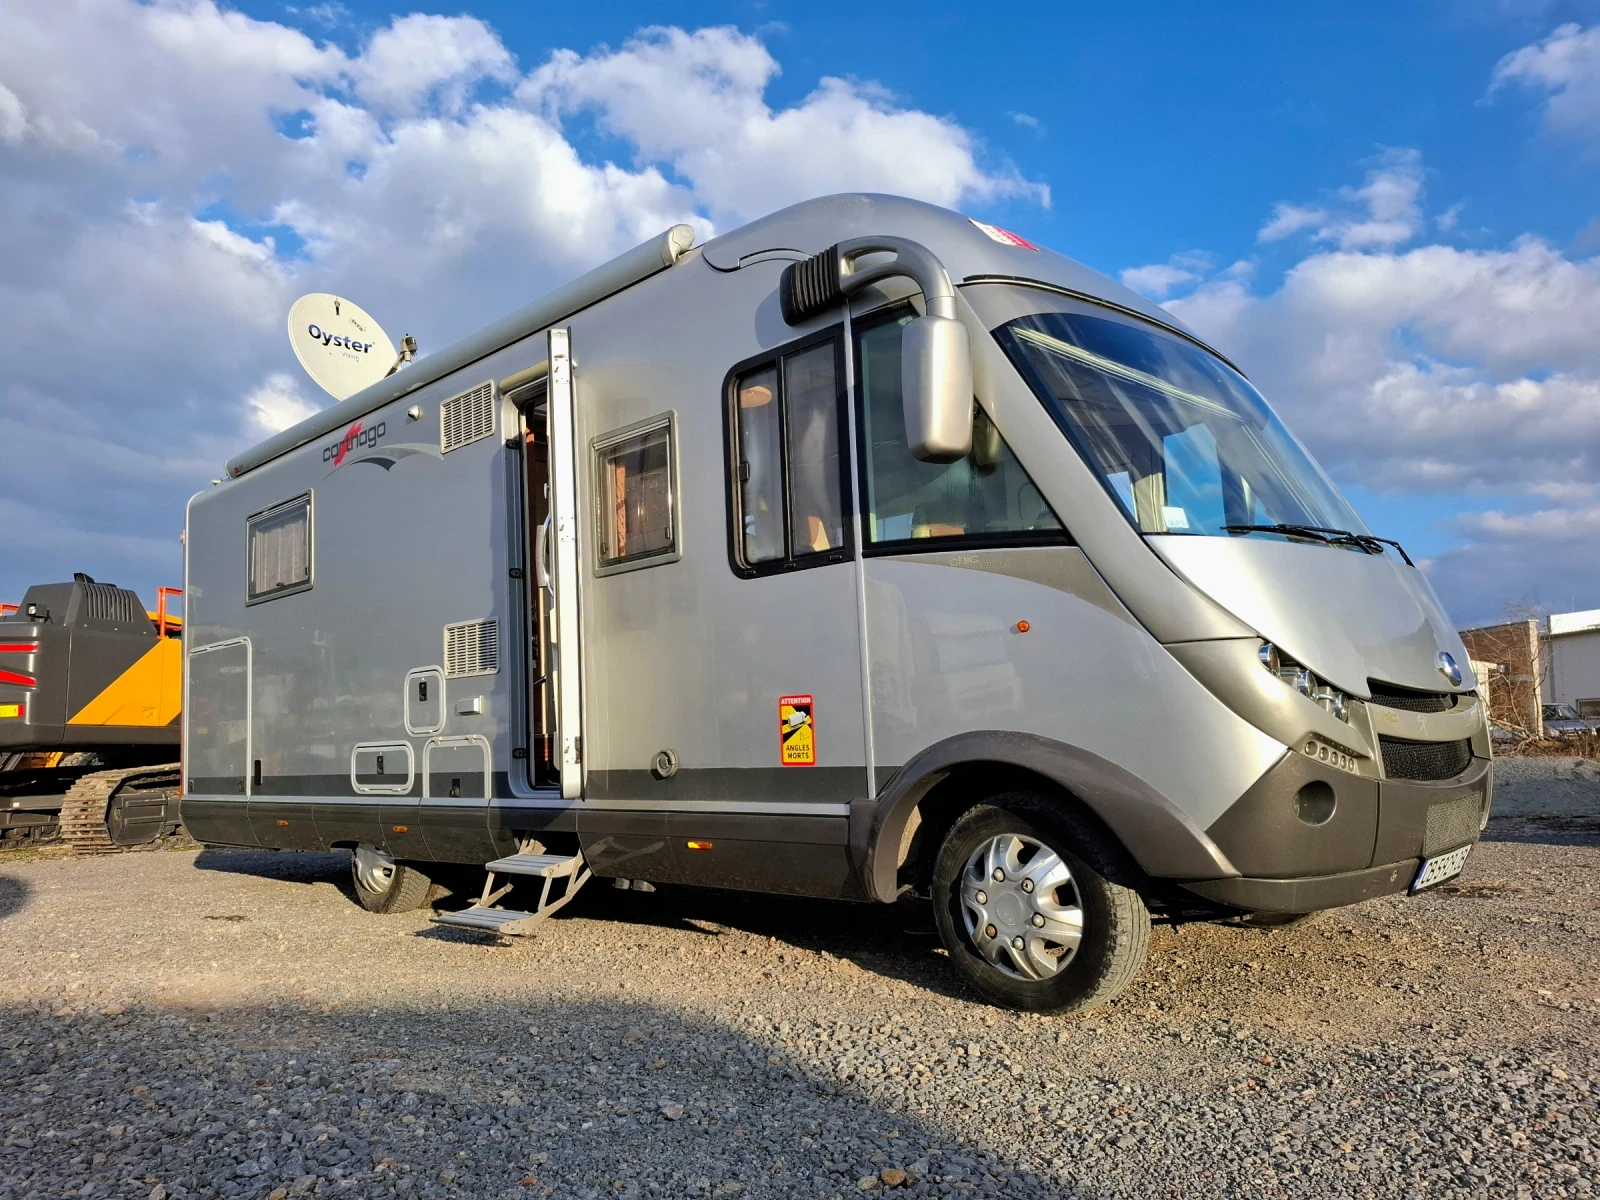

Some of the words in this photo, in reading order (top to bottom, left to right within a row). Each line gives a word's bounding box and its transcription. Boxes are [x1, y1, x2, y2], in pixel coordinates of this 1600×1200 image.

[308, 324, 373, 354] Oyster
[322, 421, 386, 463] carthago
[781, 697, 811, 705] ATTENTION
[786, 744, 810, 752] ANGLES
